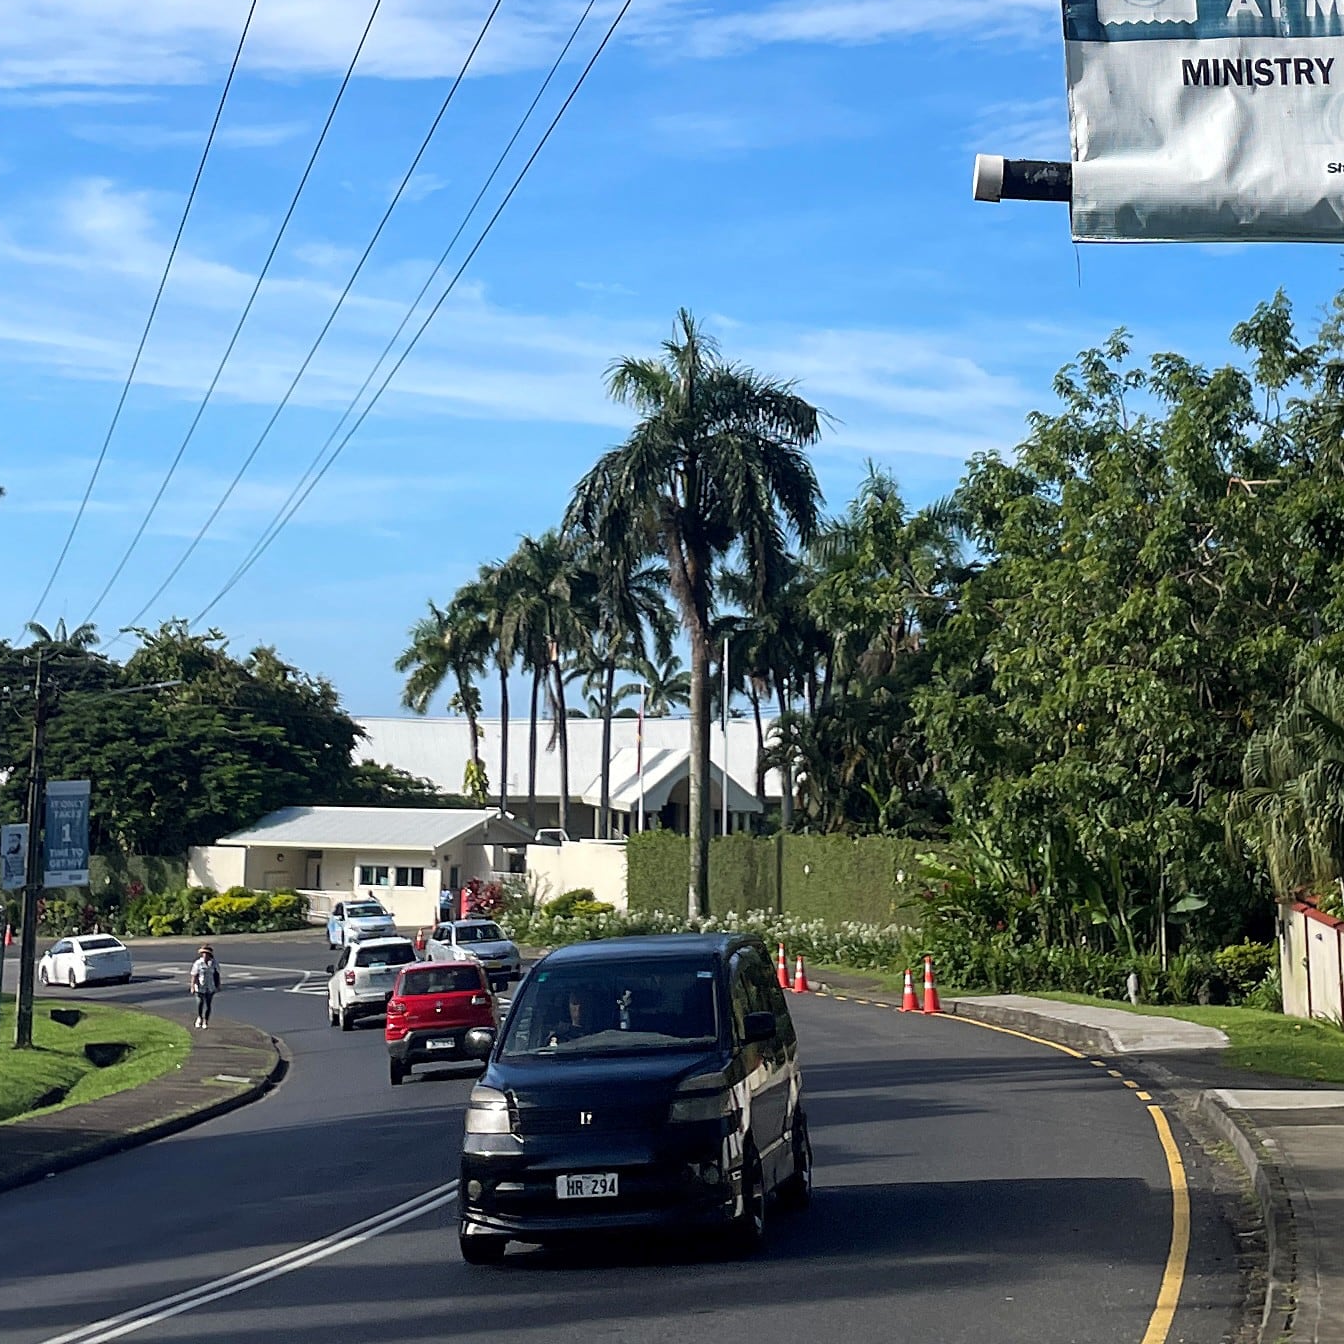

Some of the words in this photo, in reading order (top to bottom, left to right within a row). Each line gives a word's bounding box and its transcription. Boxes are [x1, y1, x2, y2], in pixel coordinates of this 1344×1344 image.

[1182, 57, 1335, 87] MINISTRY
[62, 823, 73, 842] 1
[567, 1180, 583, 1195] HR
[591, 1178, 616, 1194] 294
